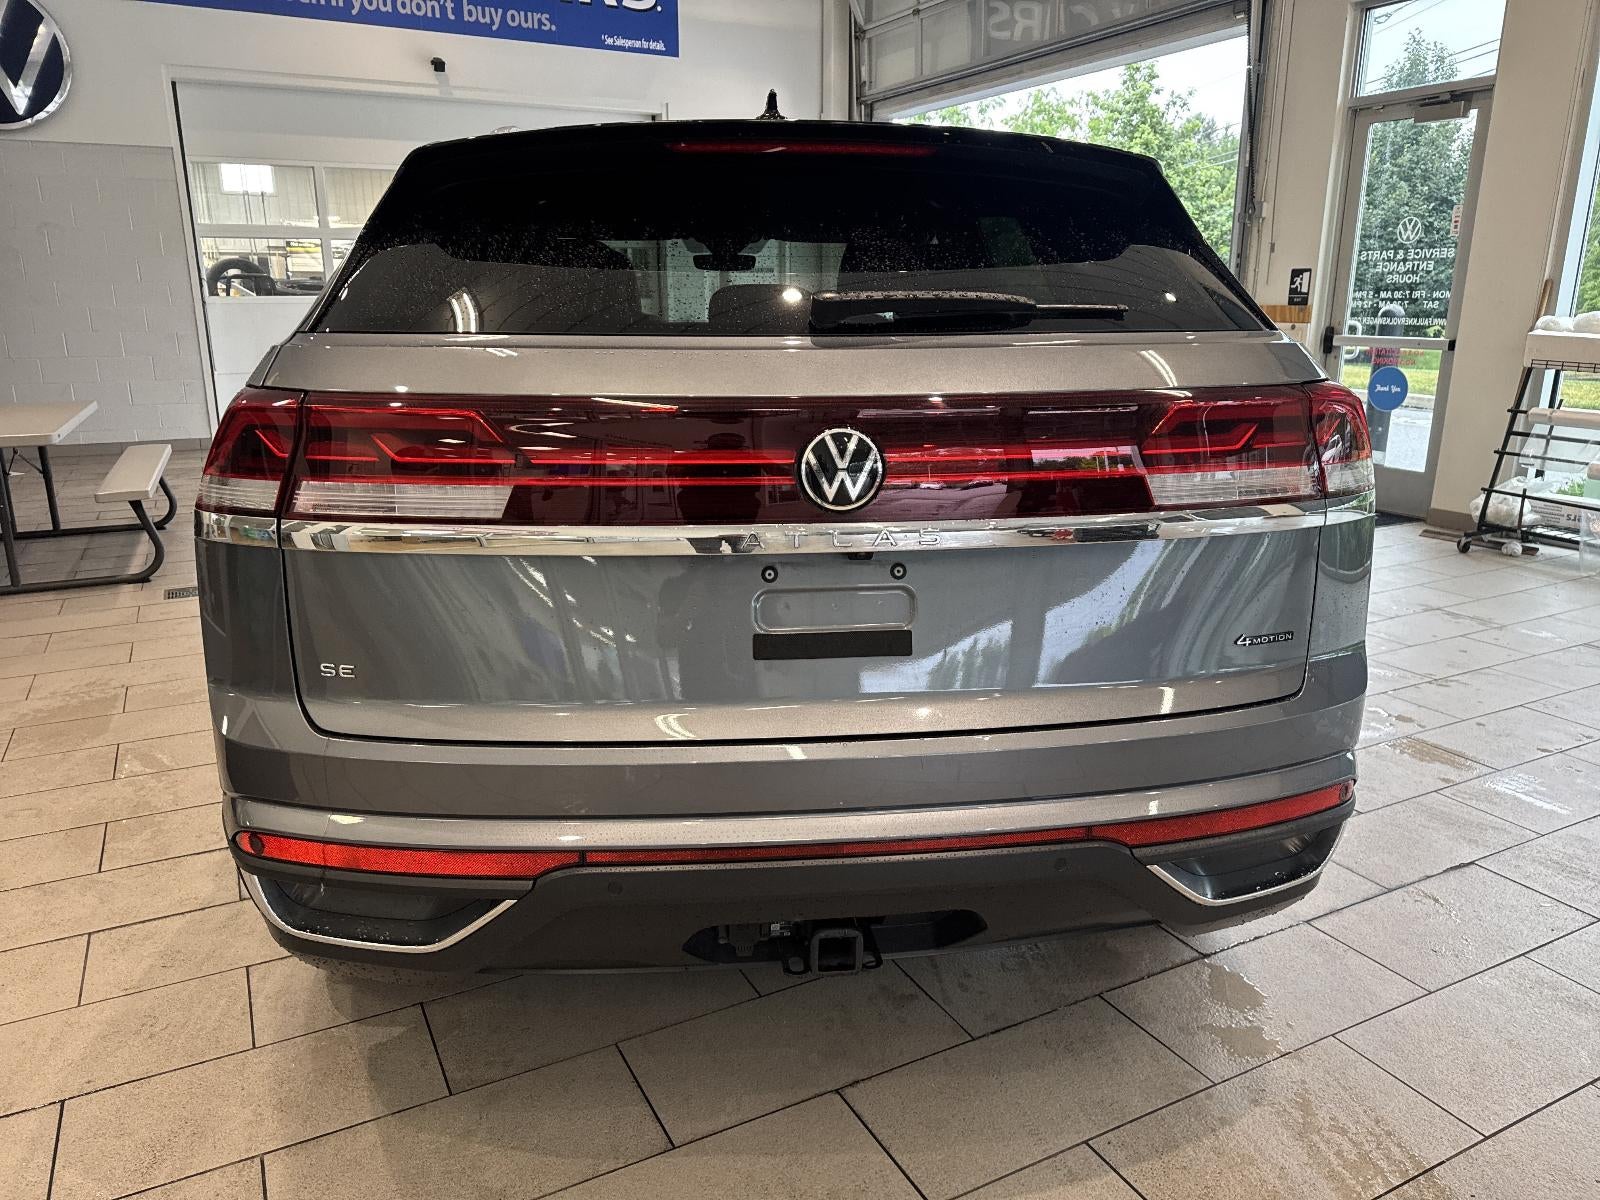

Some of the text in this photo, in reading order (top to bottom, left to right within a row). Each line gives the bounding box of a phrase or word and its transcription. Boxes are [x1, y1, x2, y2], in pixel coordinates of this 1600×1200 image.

[396, 0, 456, 20] don't
[462, 2, 503, 32] buy
[506, 9, 557, 32] ours.
[613, 35, 642, 49] Salesperson
[1375, 384, 1401, 393] Thank You
[740, 527, 942, 550] ATLAS
[1235, 632, 1293, 647] 4MOTION
[319, 662, 357, 679] SE
